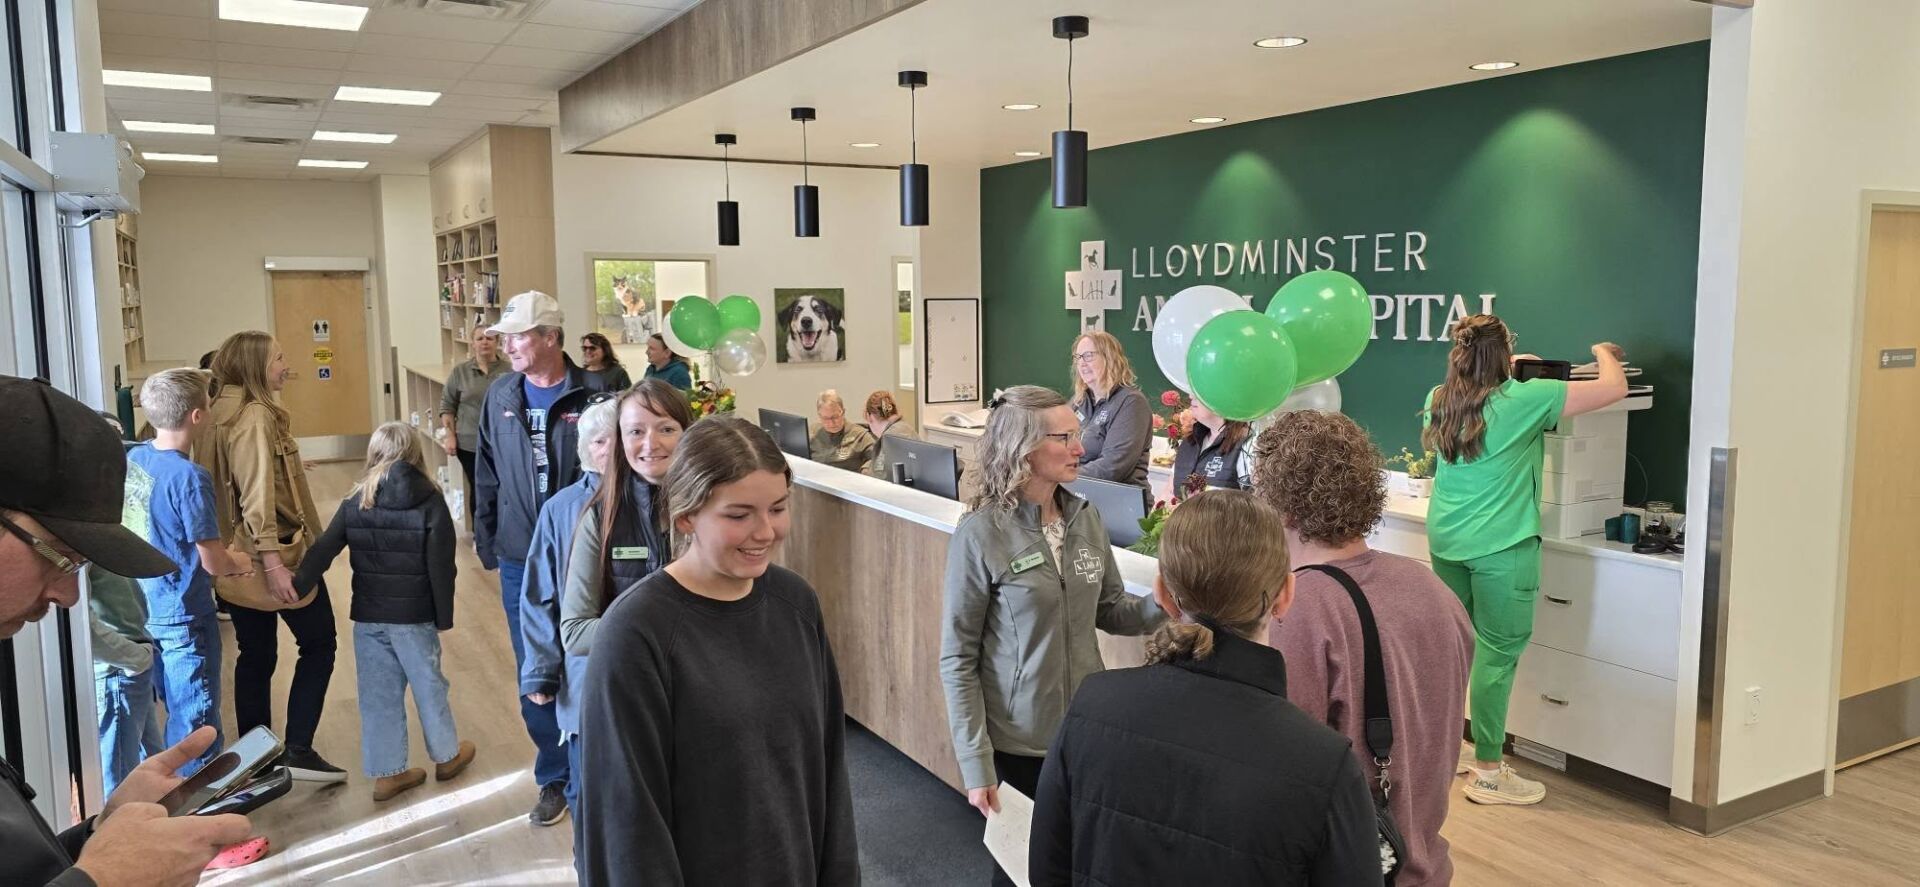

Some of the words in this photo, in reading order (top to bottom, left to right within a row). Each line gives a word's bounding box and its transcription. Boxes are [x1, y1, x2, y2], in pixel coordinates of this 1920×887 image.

[1132, 231, 1428, 278] LLOYDMINSTER
[1081, 279, 1104, 301] LAH
[1474, 778, 1499, 791] HOKA
